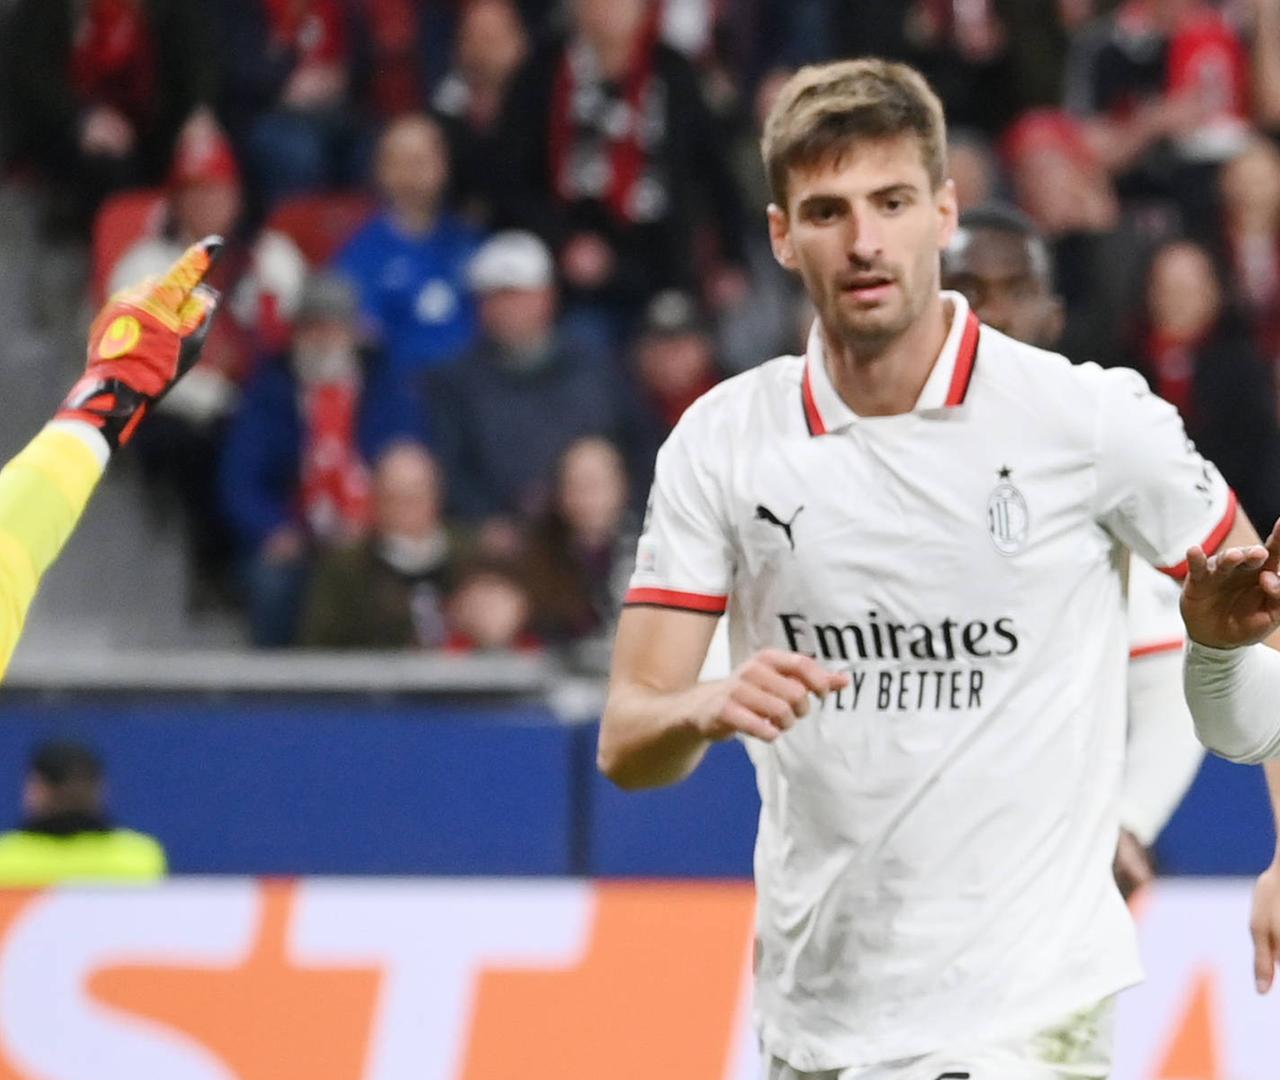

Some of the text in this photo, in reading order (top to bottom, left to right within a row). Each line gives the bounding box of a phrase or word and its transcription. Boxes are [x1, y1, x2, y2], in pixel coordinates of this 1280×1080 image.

[778, 611, 1019, 661] Emirates
[820, 669, 984, 711] LY BETTER
